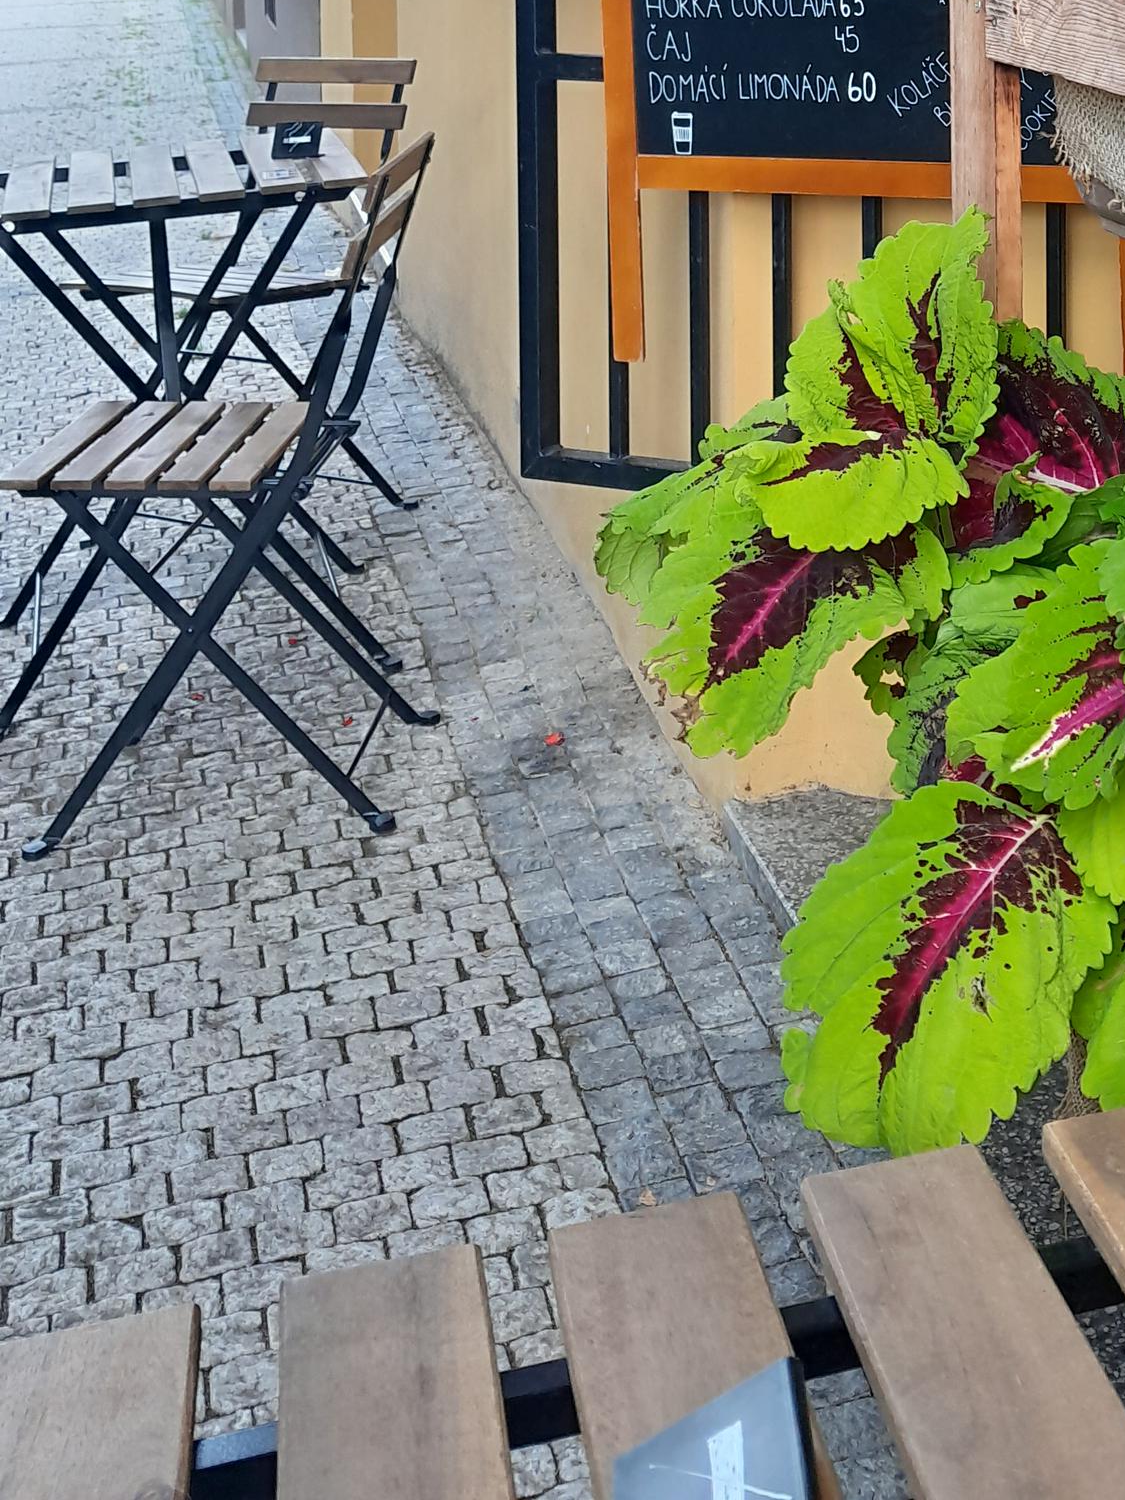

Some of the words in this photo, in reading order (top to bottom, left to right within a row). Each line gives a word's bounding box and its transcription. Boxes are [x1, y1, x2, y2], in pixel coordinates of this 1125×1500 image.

[646, 23, 692, 62] ČAJ
[834, 26, 859, 53] 45
[649, 62, 727, 104] DOMÁCÍ
[738, 63, 840, 103] LIMONÁDA
[847, 72, 876, 102] 60
